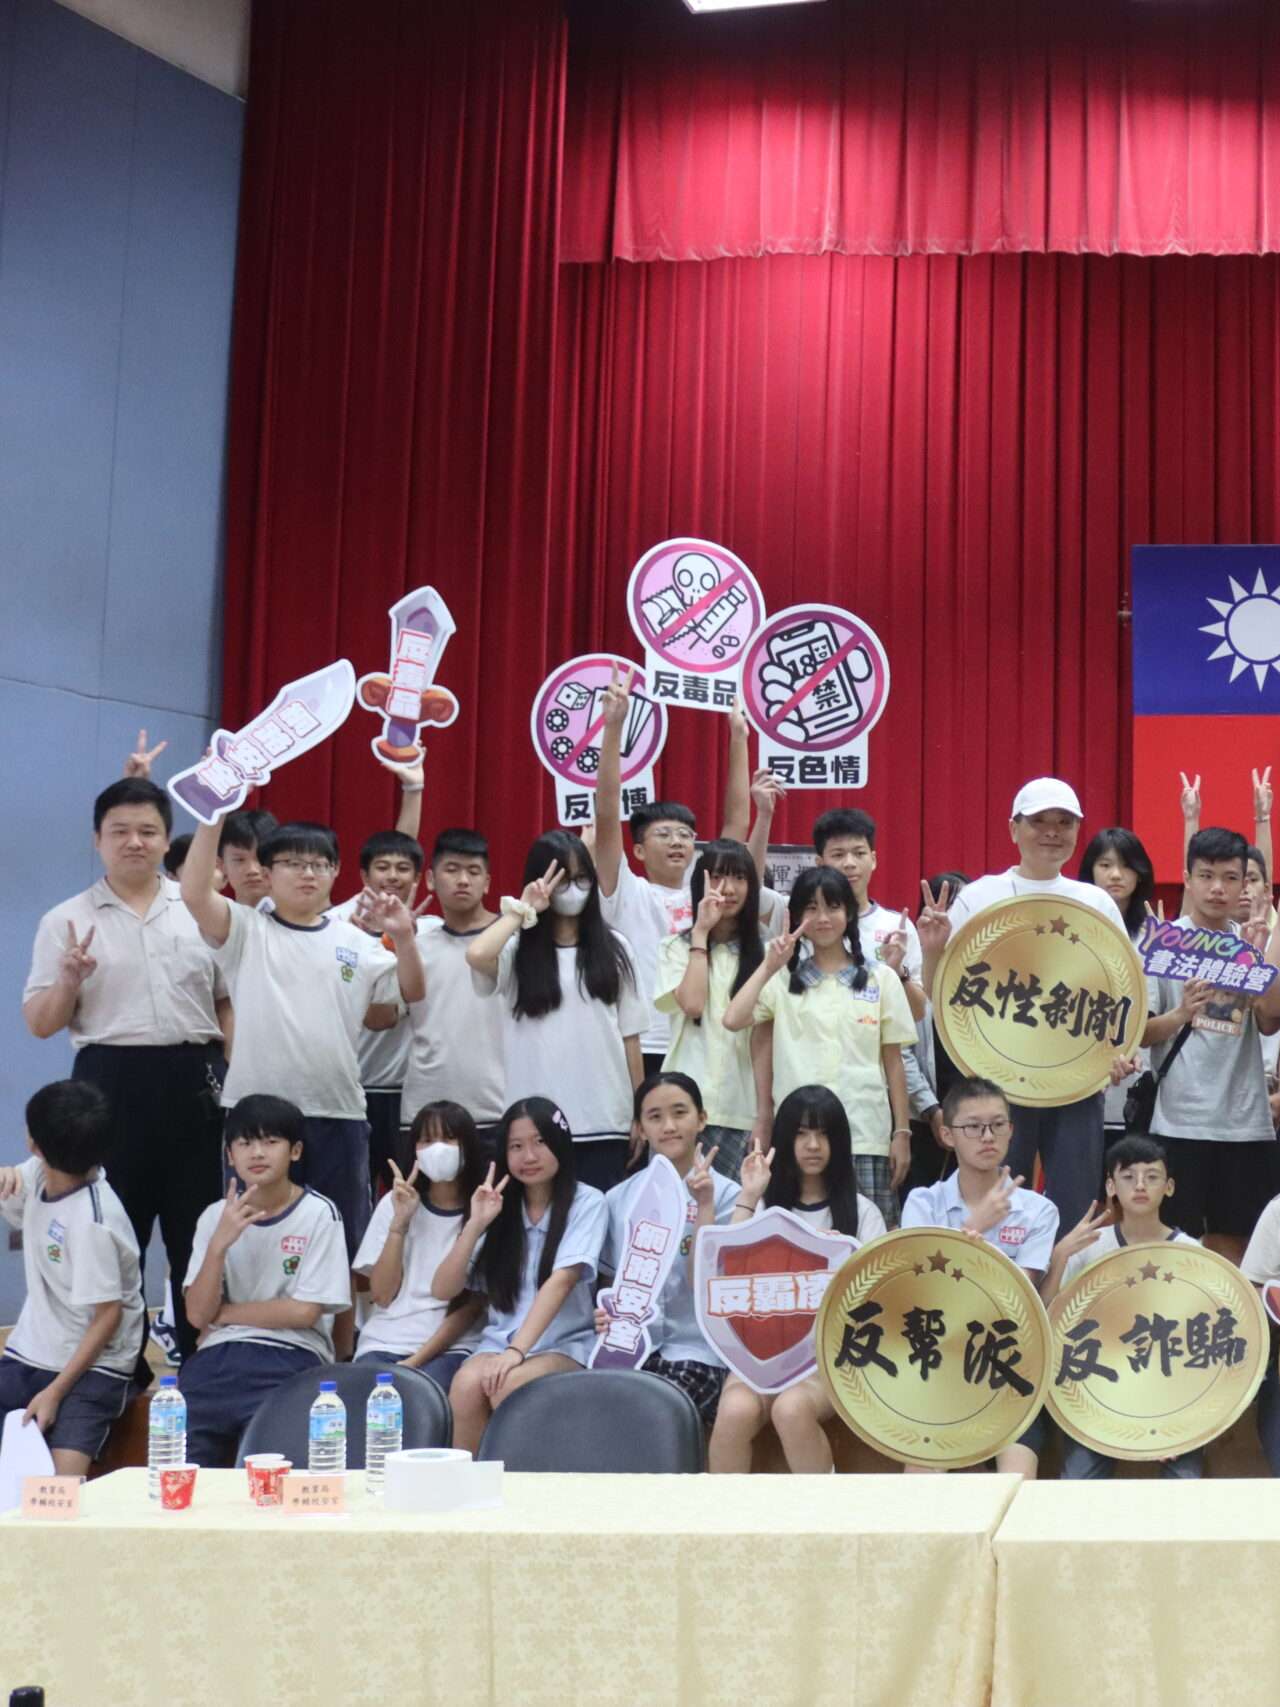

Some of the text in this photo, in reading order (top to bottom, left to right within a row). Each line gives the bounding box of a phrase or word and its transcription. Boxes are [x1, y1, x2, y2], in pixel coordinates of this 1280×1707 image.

[653, 670, 737, 706] 反毒品
[811, 679, 841, 711] 禁
[767, 755, 860, 785] 反色情
[565, 787, 647, 820] 反博
[1142, 920, 1243, 958] YOUNG
[1146, 949, 1275, 992] 書法體驗營
[949, 961, 1131, 1047] 反性剝削
[604, 1220, 672, 1354] 網路安全
[1054, 1307, 1248, 1386] 反詐騙
